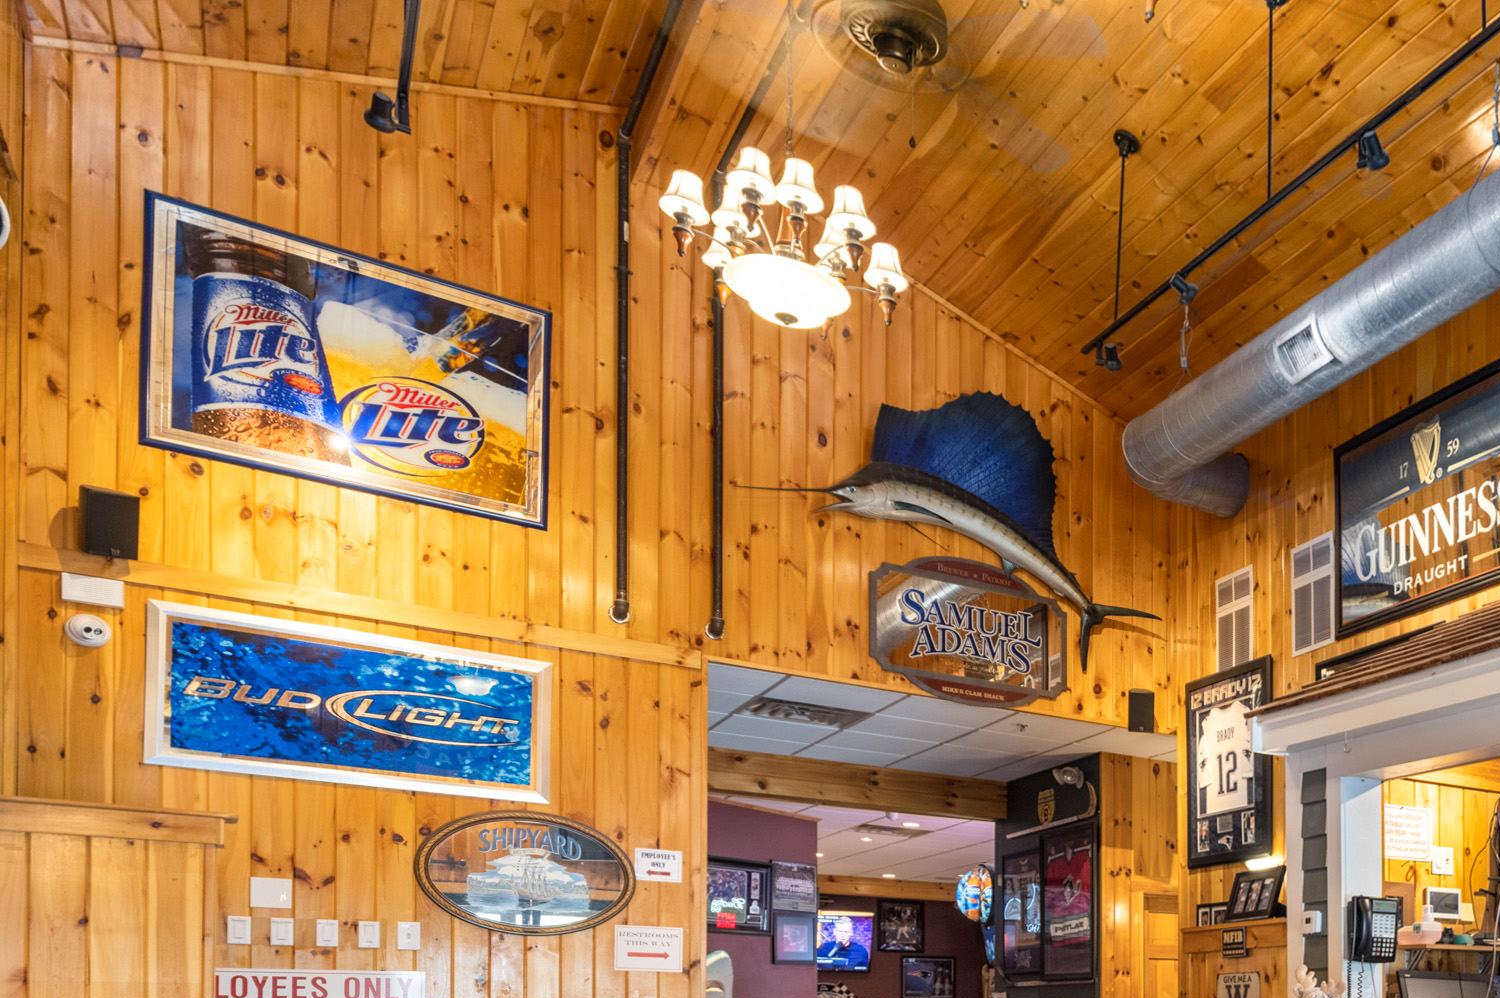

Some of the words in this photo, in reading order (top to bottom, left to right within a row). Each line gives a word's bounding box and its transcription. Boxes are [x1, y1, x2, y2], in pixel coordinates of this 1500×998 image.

[225, 304, 297, 326] Miller
[203, 324, 318, 382] Lite
[377, 382, 462, 410] Miller
[349, 401, 482, 449] Lite
[1399, 462, 1409, 480] 17
[1446, 437, 1460, 458] 59
[1393, 554, 1468, 596] DRAUGHT
[900, 588, 1042, 648] SAMUEL
[909, 624, 1032, 675] ADAMS
[182, 675, 323, 712] BUD
[353, 697, 520, 736] LIGHT
[941, 685, 964, 695] MIKE'S
[965, 689, 983, 698] CLAM
[984, 692, 1005, 701] SHACK
[1203, 678, 1247, 706] BRADY
[1216, 726, 1235, 743] BRADY
[1216, 750, 1238, 796] 12
[478, 827, 582, 861] SHIPYARD
[640, 851, 676, 861] EMPLOYEE'S
[650, 860, 667, 868] ONLY
[618, 931, 680, 940] RESTROOMS
[624, 939, 648, 947] THIS
[650, 940, 673, 948] WAY
[1223, 975, 1237, 984] GIVE
[1238, 975, 1247, 983] ME
